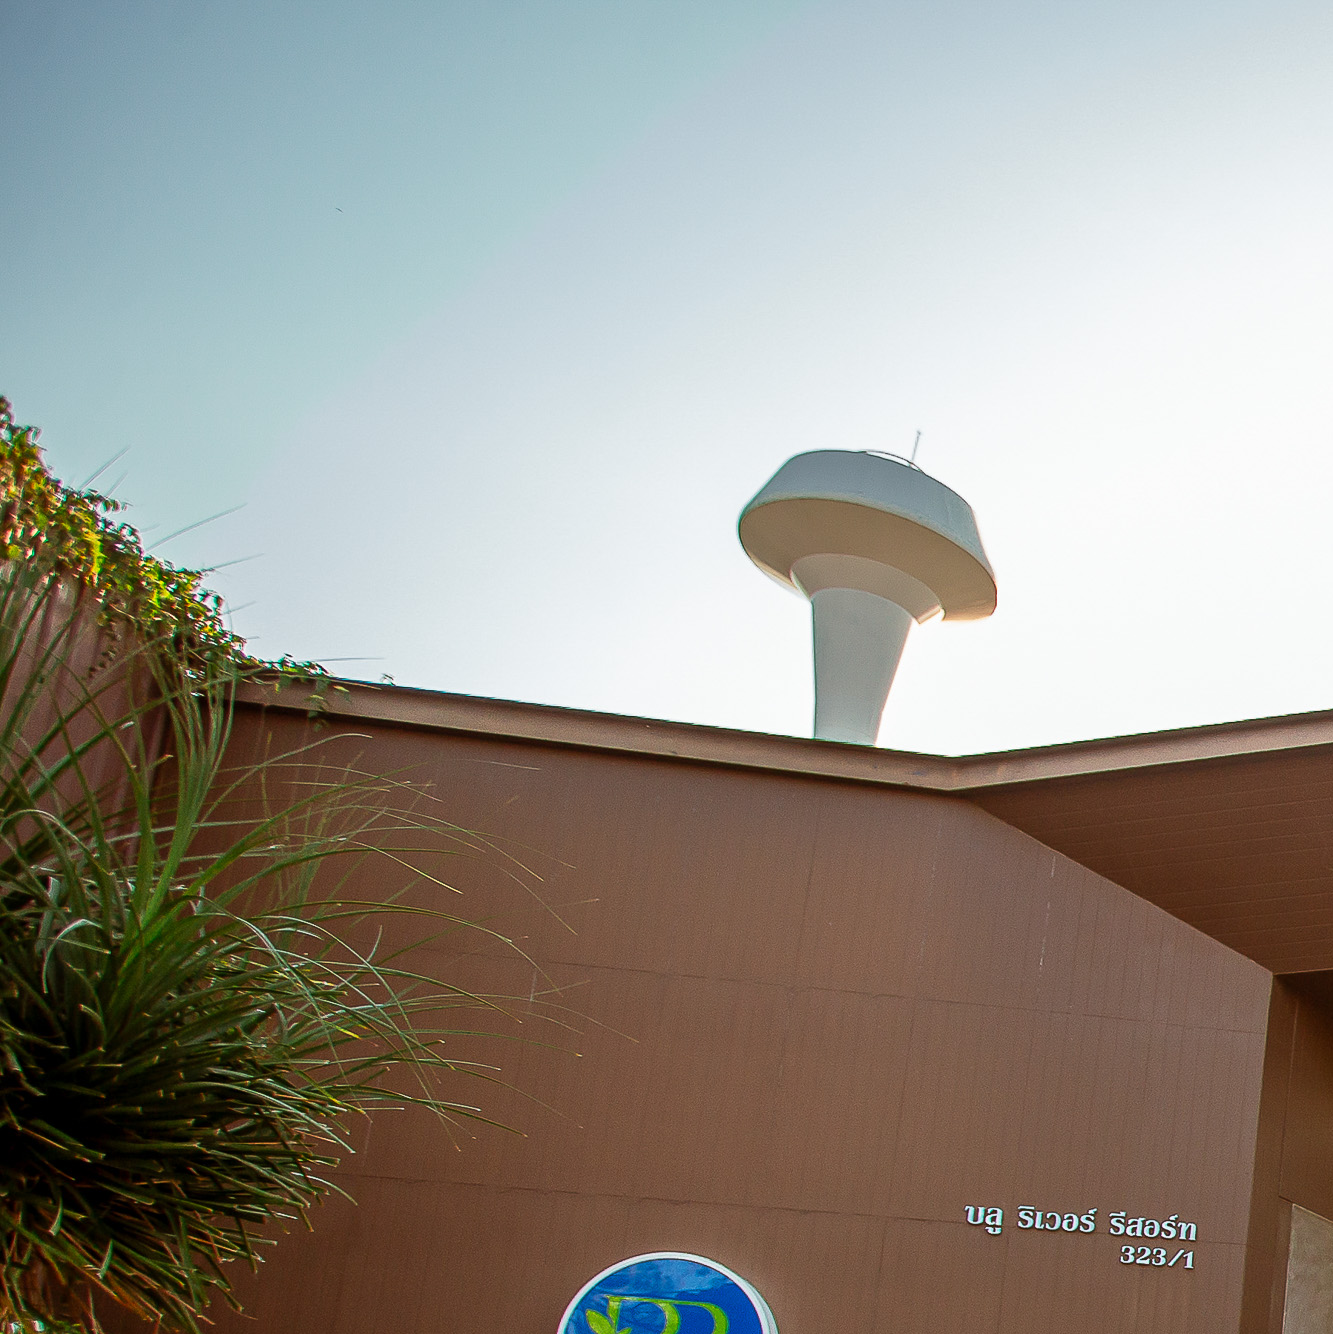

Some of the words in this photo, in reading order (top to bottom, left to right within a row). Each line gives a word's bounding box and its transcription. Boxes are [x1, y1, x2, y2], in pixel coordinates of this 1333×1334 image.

[964, 1205, 1003, 1235] บลู
[1017, 1205, 1098, 1233] ริเวอร์
[1109, 1211, 1198, 1242] รีสอร์ท
[1119, 1245, 1195, 1269] 323/1
